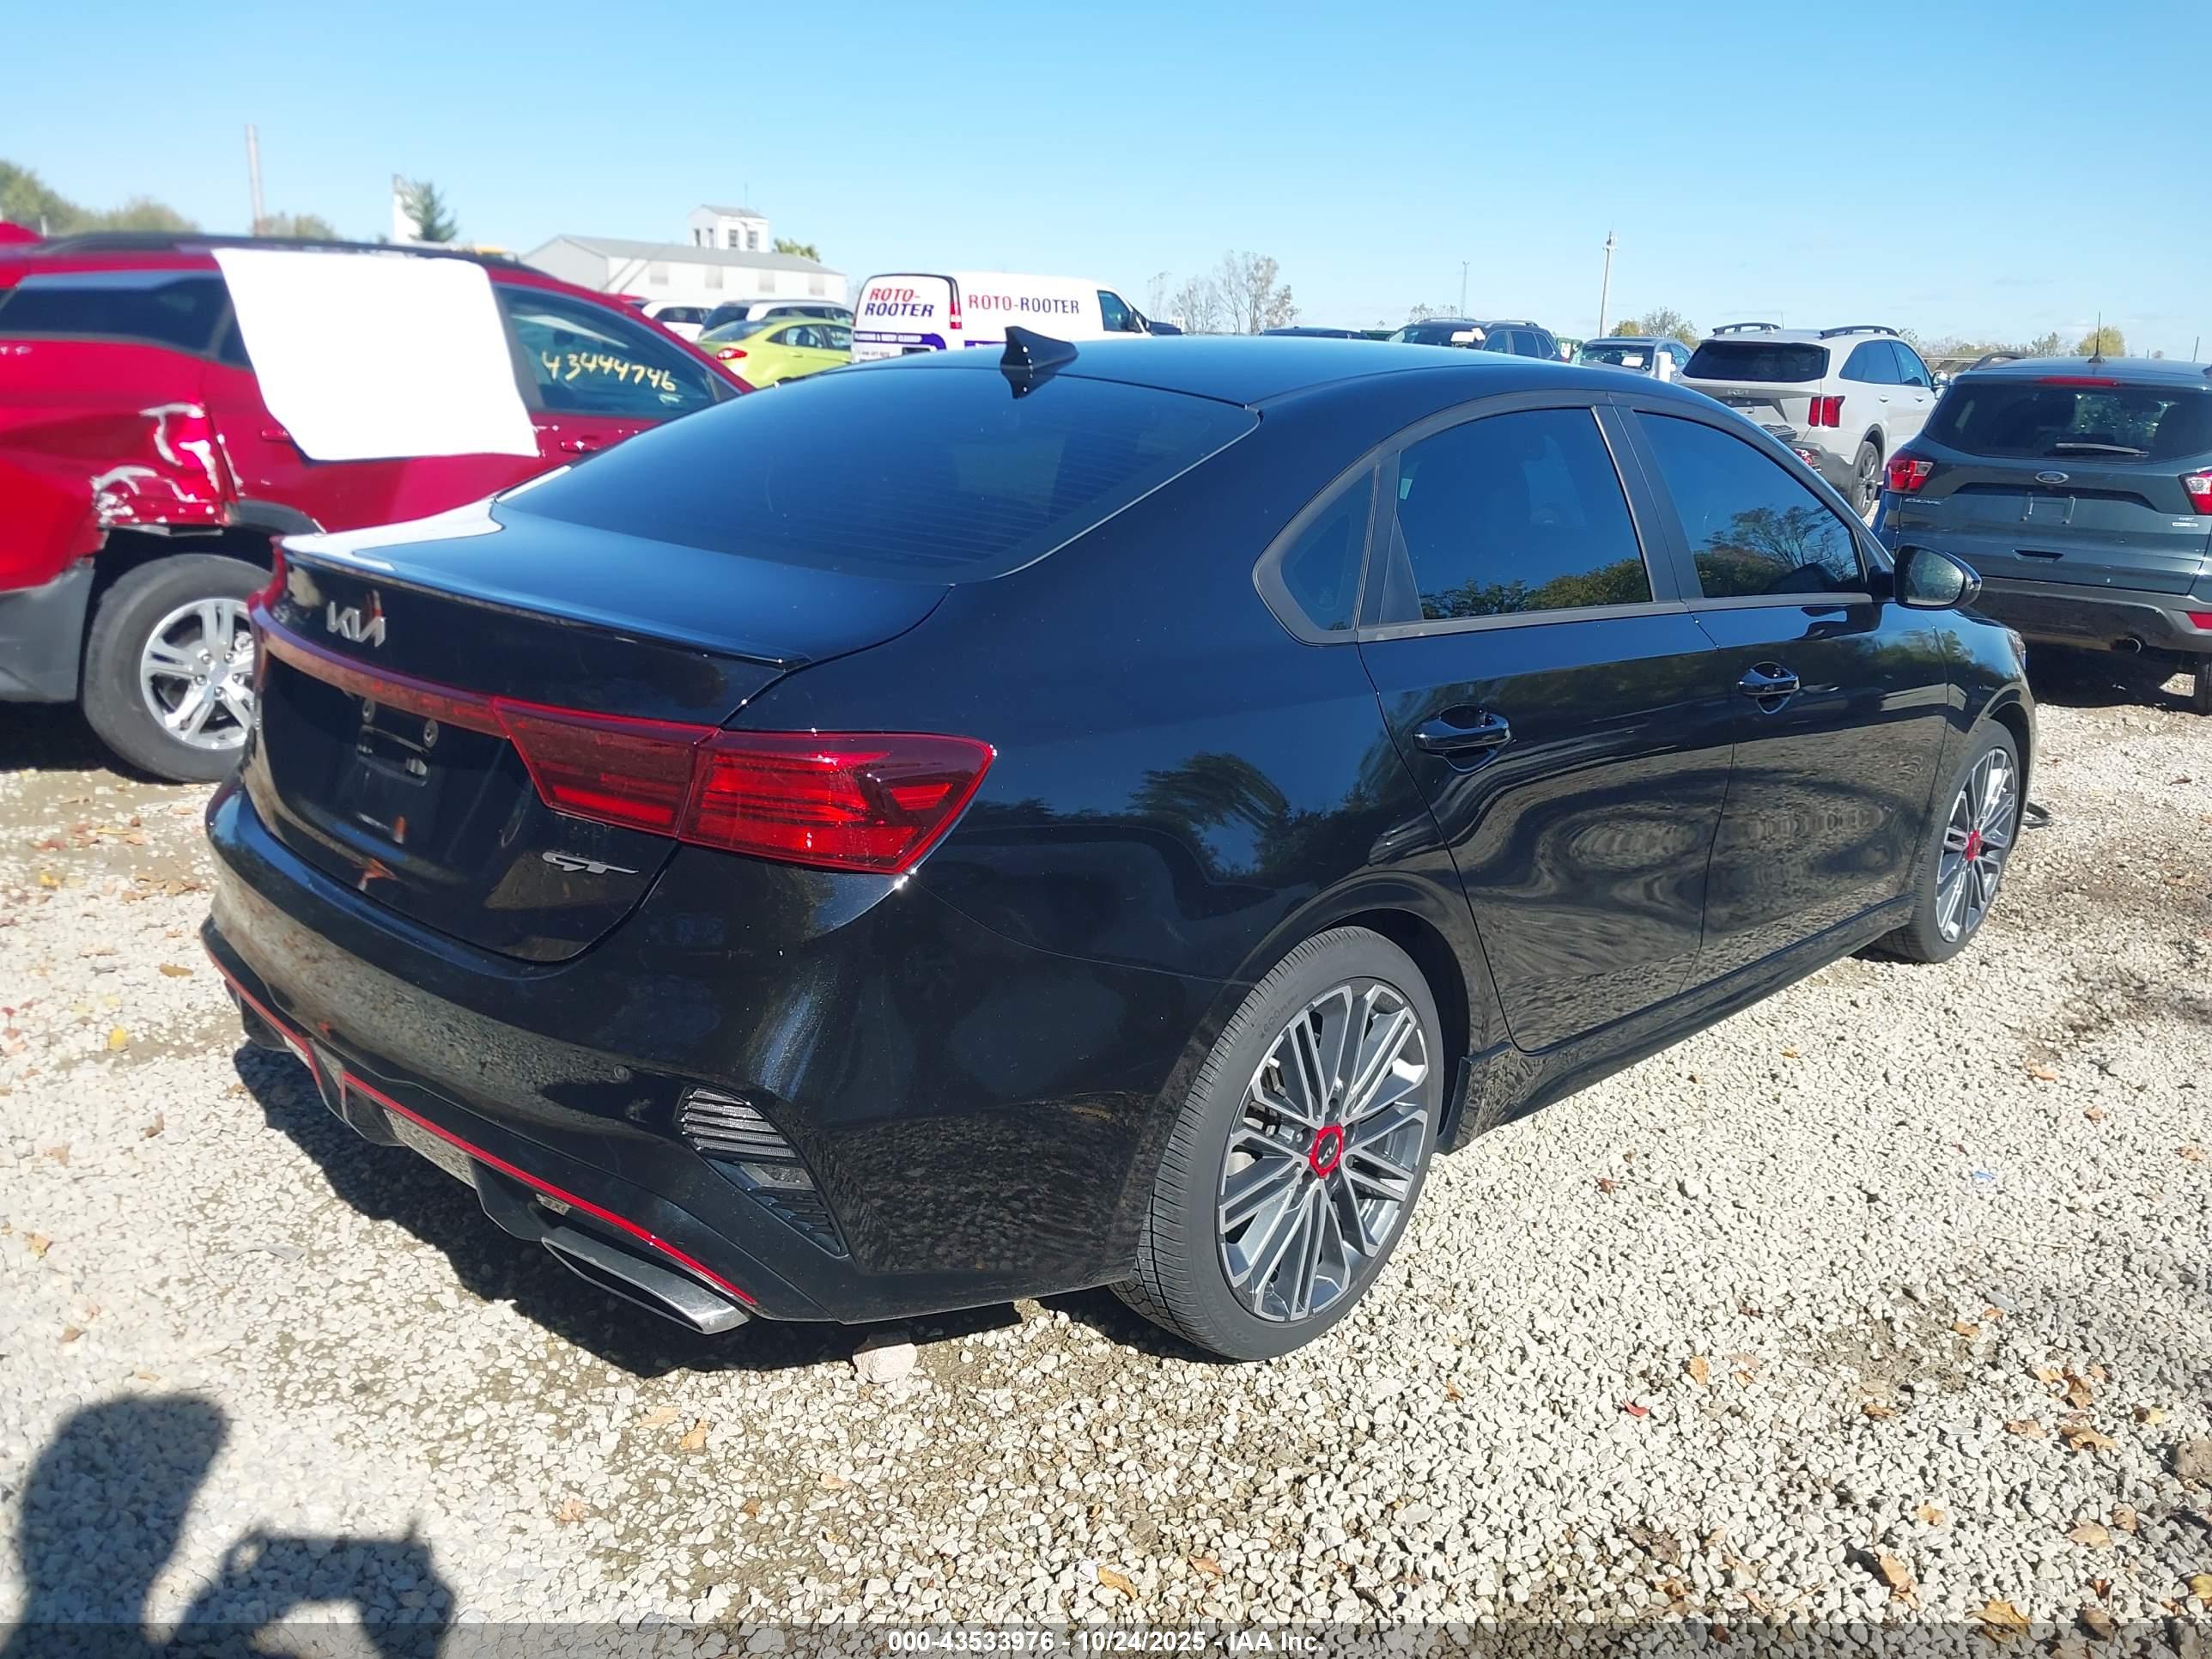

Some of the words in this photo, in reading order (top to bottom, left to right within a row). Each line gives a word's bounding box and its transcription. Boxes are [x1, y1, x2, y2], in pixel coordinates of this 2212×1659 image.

[870, 288, 921, 302] ROTO-
[969, 295, 1079, 313] ROTO-ROOTER
[865, 302, 934, 317] ROOTER
[326, 600, 386, 647] KIA
[542, 851, 640, 874] GT
